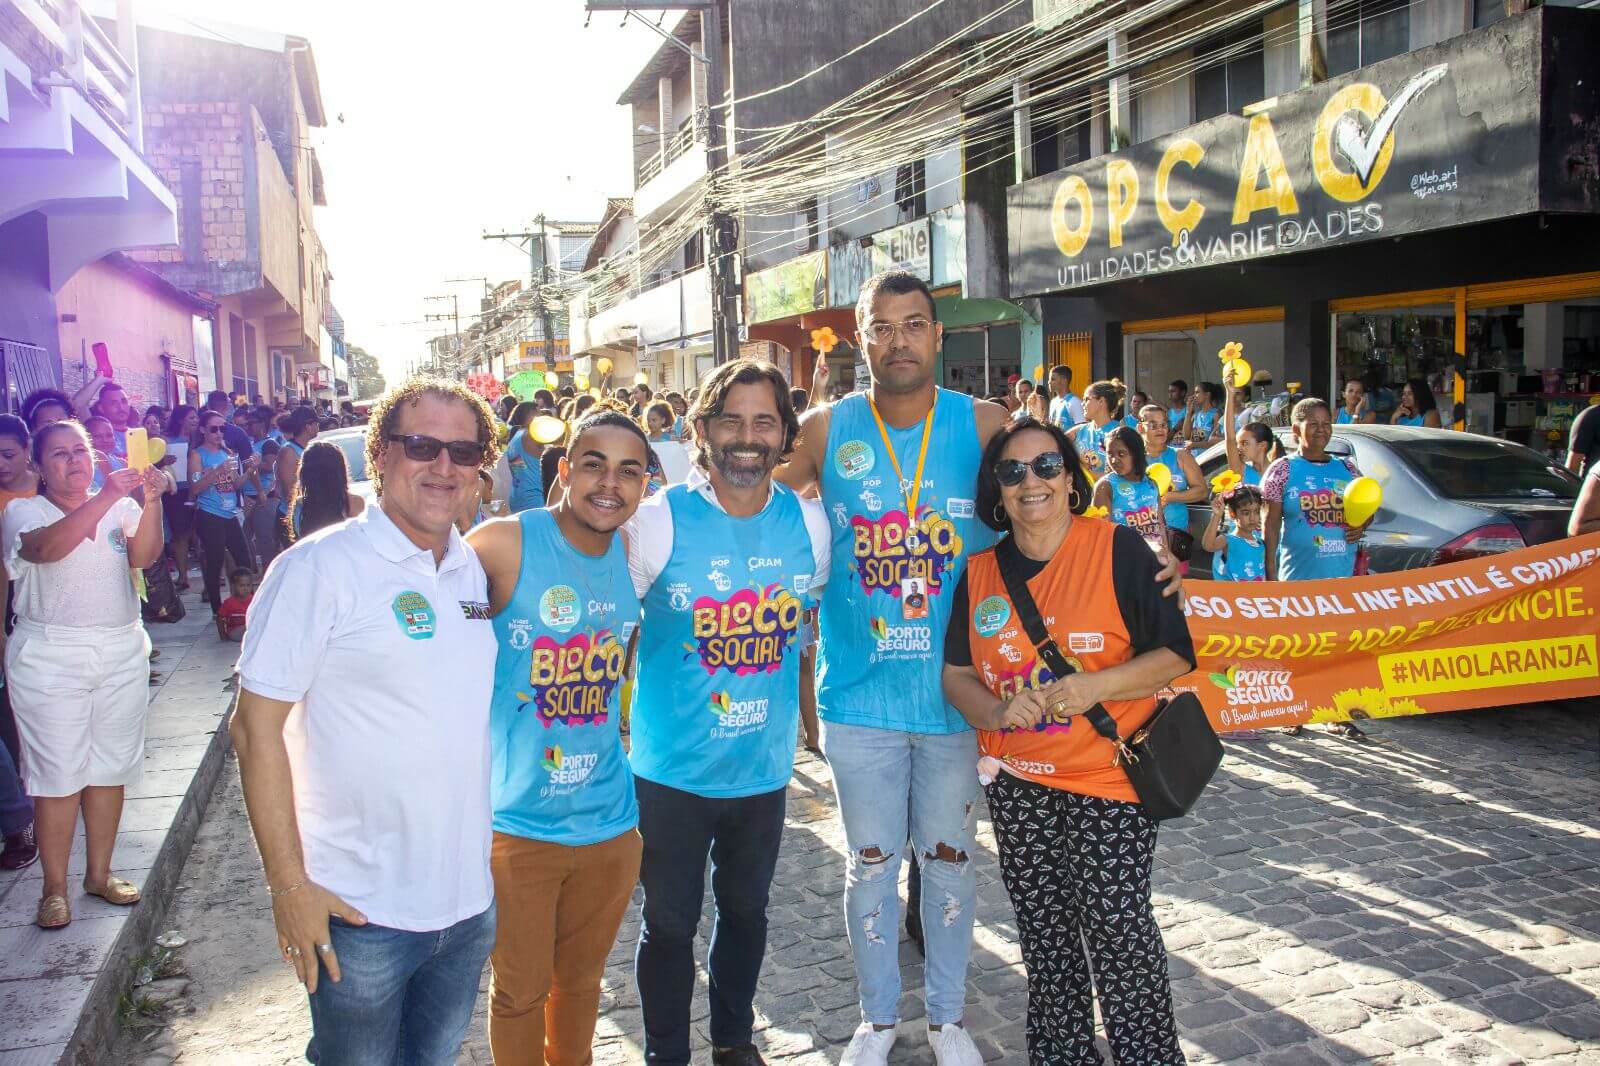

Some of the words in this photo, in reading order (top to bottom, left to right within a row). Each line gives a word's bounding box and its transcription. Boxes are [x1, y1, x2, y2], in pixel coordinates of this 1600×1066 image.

[1051, 82, 1395, 257] OPÇÃO
[890, 225, 928, 263] Elite
[1058, 246, 1174, 287] UTILIDADES
[1193, 203, 1384, 263] VARIEDADES
[862, 480, 882, 488] POP
[1300, 493, 1344, 511] BLOC
[1308, 510, 1345, 524] SOCIA
[854, 520, 956, 559] BLOCO
[711, 559, 730, 567] POP
[747, 557, 782, 571] CRAM
[1235, 592, 1356, 619] SEXUAL
[1352, 574, 1491, 612] INFANTIL
[1485, 565, 1515, 589] É
[587, 600, 616, 615] CRAM
[693, 597, 802, 638] BLOCO
[884, 627, 931, 640] PORTO
[998, 630, 1018, 640] POP
[1346, 626, 1407, 653] 100
[706, 635, 782, 666] SOCIAL
[877, 639, 931, 652] SEGURO
[1088, 641, 1101, 649] 100
[530, 644, 625, 686] BLOCO
[1391, 643, 1593, 684] #MAIOLARANJA
[1234, 670, 1293, 687] PORTO
[543, 685, 608, 718] SOCIAL
[1225, 684, 1295, 706] SEGURO
[729, 698, 769, 714] PORTO
[718, 711, 768, 727] SEGURO
[1231, 706, 1260, 725] Brasil
[560, 753, 598, 770] PORTO
[548, 766, 594, 784] SEGUR
